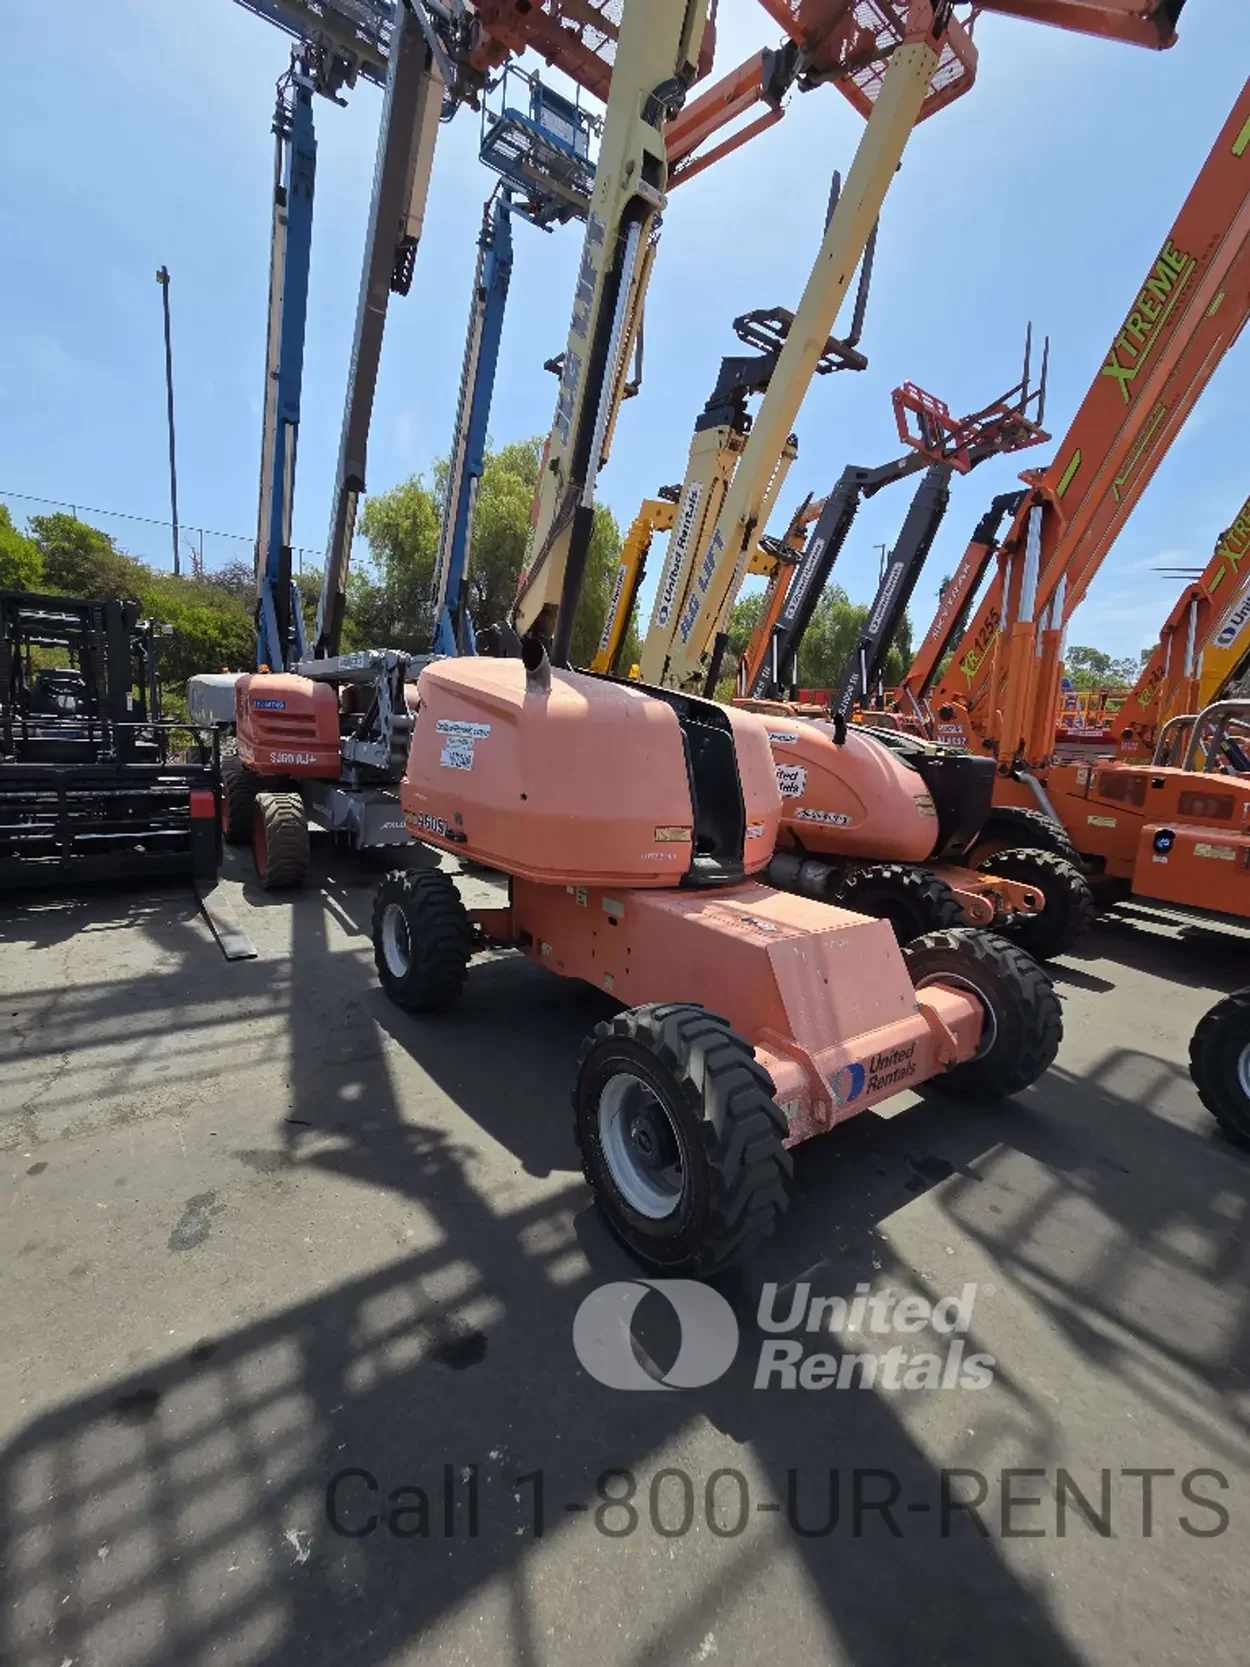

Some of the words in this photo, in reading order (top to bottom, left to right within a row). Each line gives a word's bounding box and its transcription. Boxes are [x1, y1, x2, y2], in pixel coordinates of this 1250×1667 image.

[1101, 239, 1190, 404] XTREME
[663, 551, 684, 603] United
[676, 489, 699, 548] Rentals
[866, 1061, 917, 1095] Rentals
[868, 1041, 916, 1075] United
